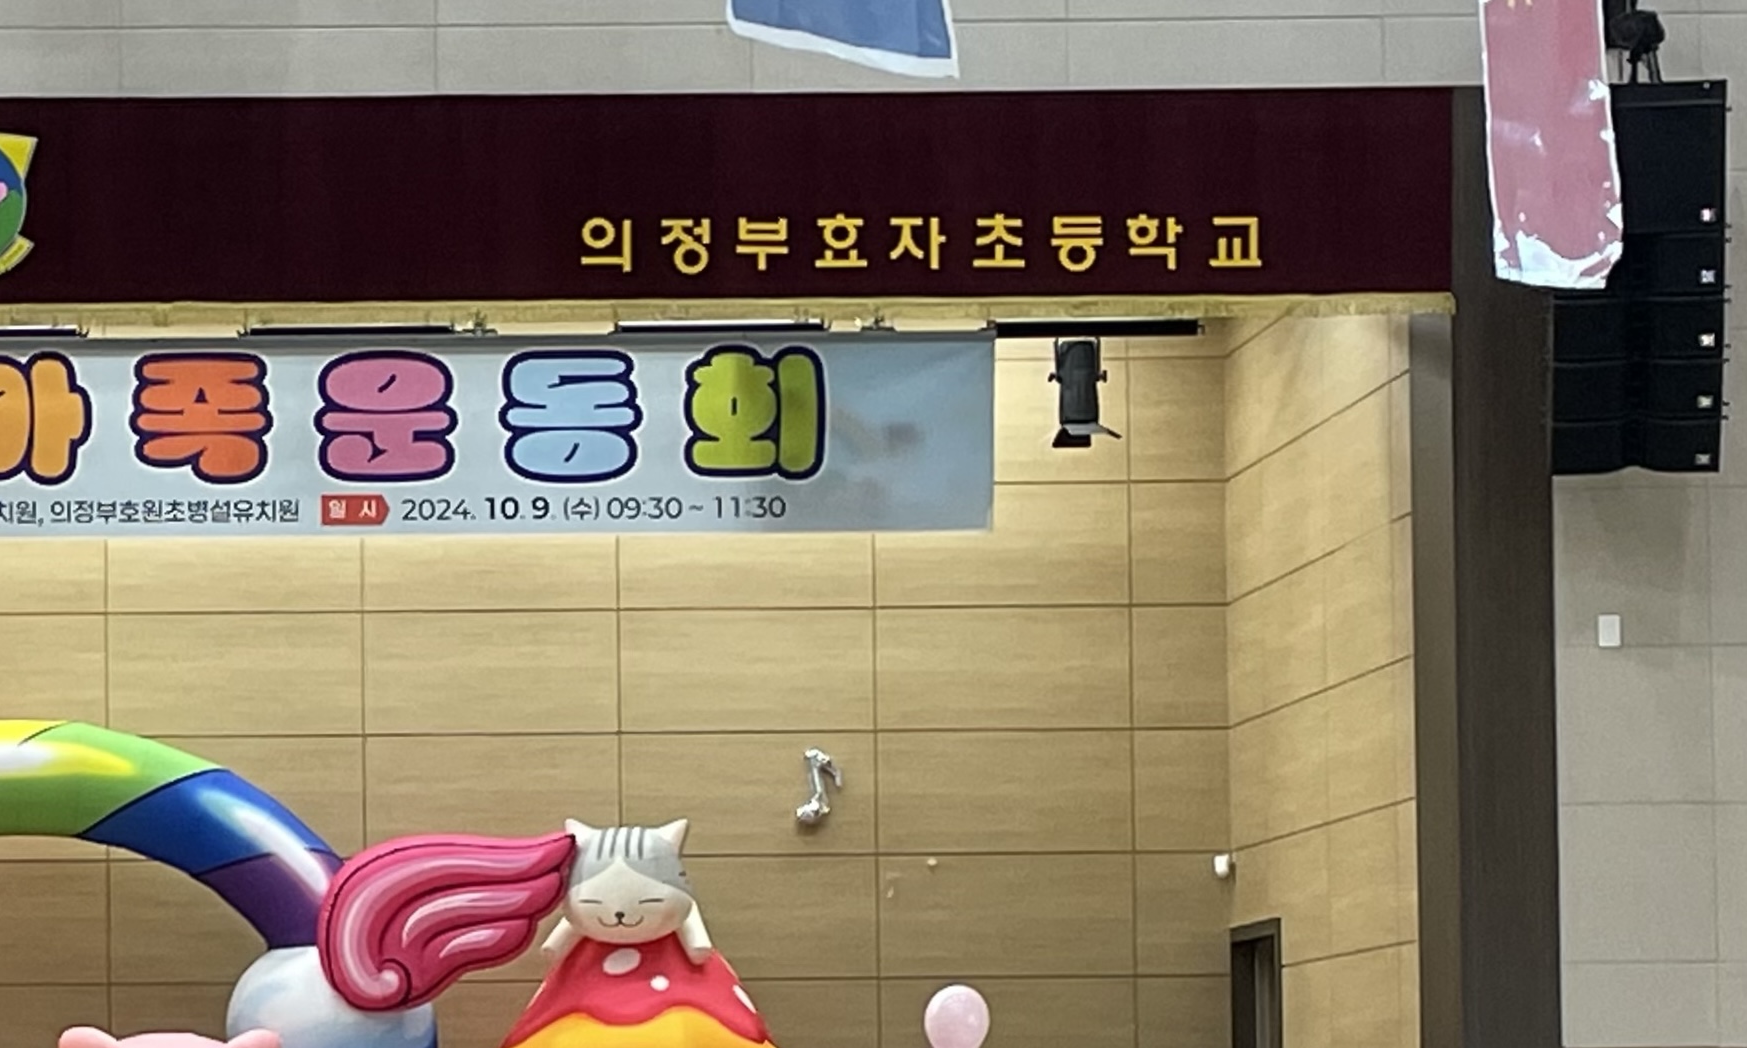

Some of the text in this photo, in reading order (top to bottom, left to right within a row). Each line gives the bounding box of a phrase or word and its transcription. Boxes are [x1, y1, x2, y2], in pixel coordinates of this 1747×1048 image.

[580, 213, 1263, 275] 의정부효자초등학교
[50, 499, 300, 524] 의정부호원초병설유치원
[400, 498, 477, 521] 2024.
[562, 495, 600, 521] (수)
[606, 496, 683, 519] 09:30
[715, 495, 787, 519] 11:30
